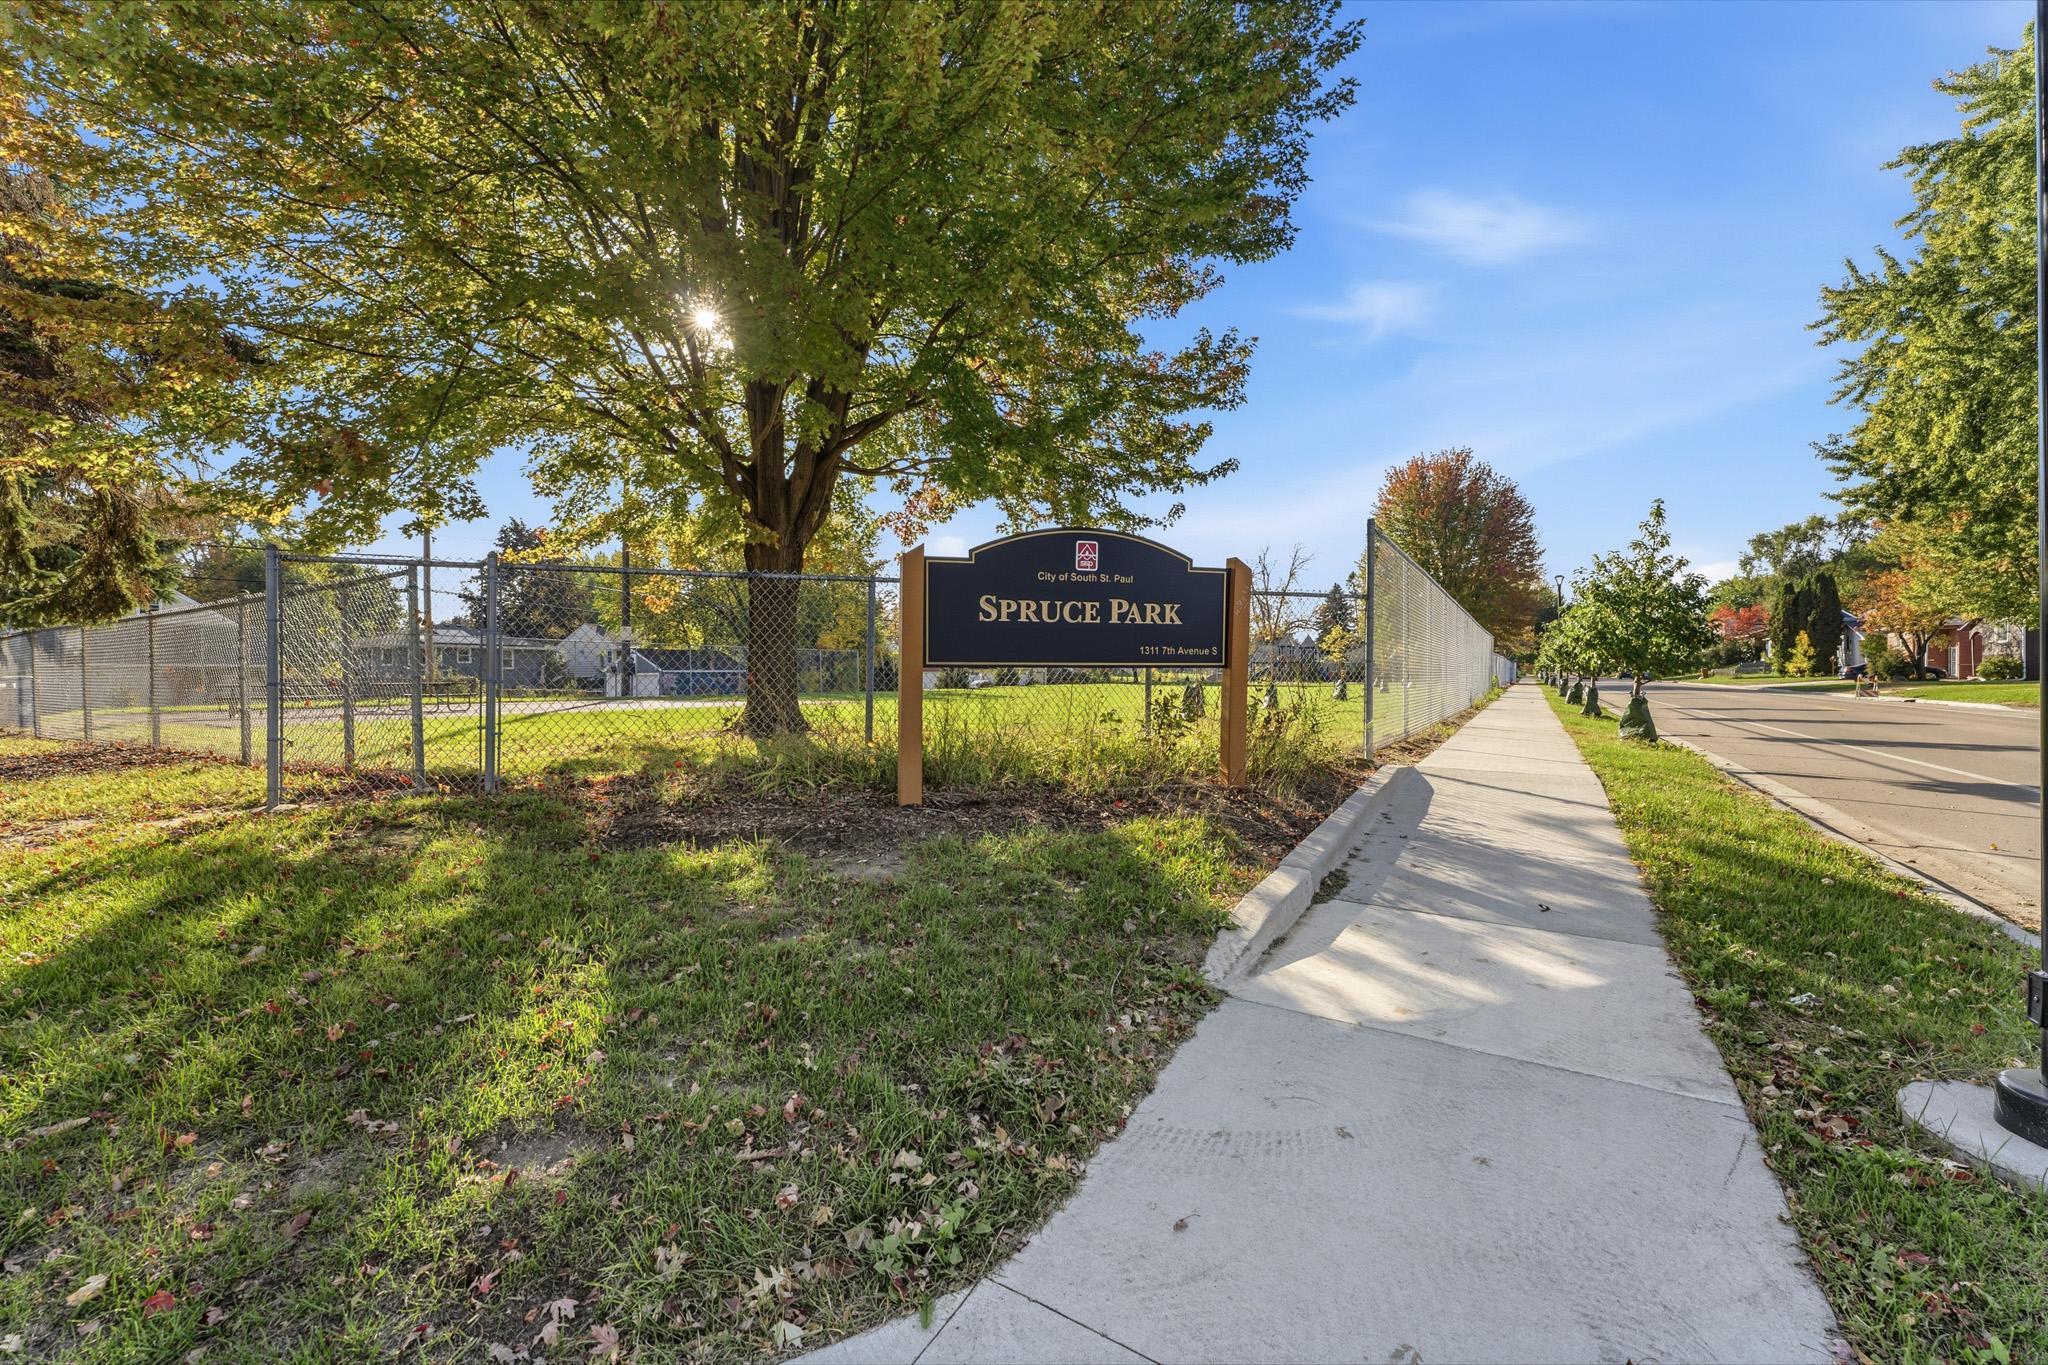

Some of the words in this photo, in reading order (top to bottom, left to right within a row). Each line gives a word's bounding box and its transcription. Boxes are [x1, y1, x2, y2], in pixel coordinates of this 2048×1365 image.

[1037, 571, 1056, 583] City
[1059, 572, 1069, 581] of
[1070, 572, 1097, 582] South
[1100, 573, 1112, 583] St.
[1114, 574, 1134, 584] Paul
[1139, 646, 1159, 655] 1311
[1162, 646, 1176, 655] 7th
[1177, 646, 1210, 656] Avenue
[1211, 646, 1218, 656] S
